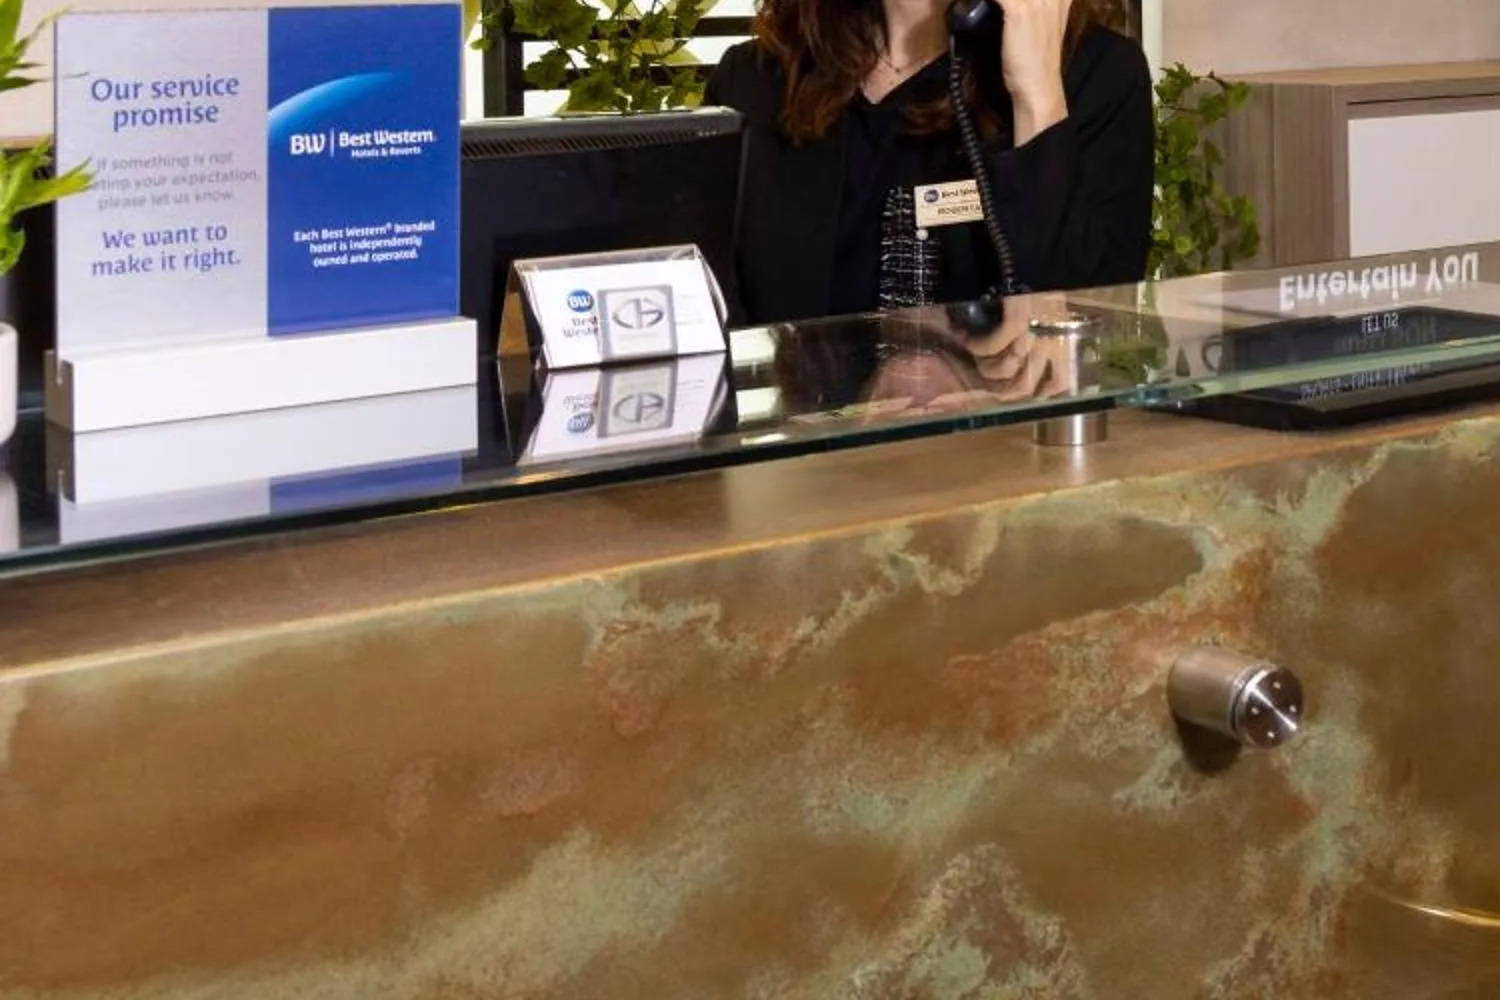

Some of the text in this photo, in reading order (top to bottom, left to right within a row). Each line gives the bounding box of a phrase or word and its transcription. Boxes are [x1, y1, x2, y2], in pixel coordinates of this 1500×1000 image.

[91, 73, 240, 101] Our service
[113, 103, 220, 132] promise
[290, 132, 326, 155] BW
[339, 131, 372, 147] Best
[111, 154, 190, 172] something
[194, 152, 205, 166] is
[209, 151, 233, 165] not
[134, 175, 168, 194] your
[98, 194, 147, 213] please
[151, 192, 171, 207] let
[173, 192, 191, 206] us
[102, 224, 228, 249] We want to
[293, 229, 319, 243] Each
[321, 228, 344, 240] Best
[393, 220, 436, 234] branded
[309, 235, 424, 254] hotel is independently
[92, 248, 242, 276] make it right.
[312, 254, 349, 268] owned
[350, 252, 370, 265] and
